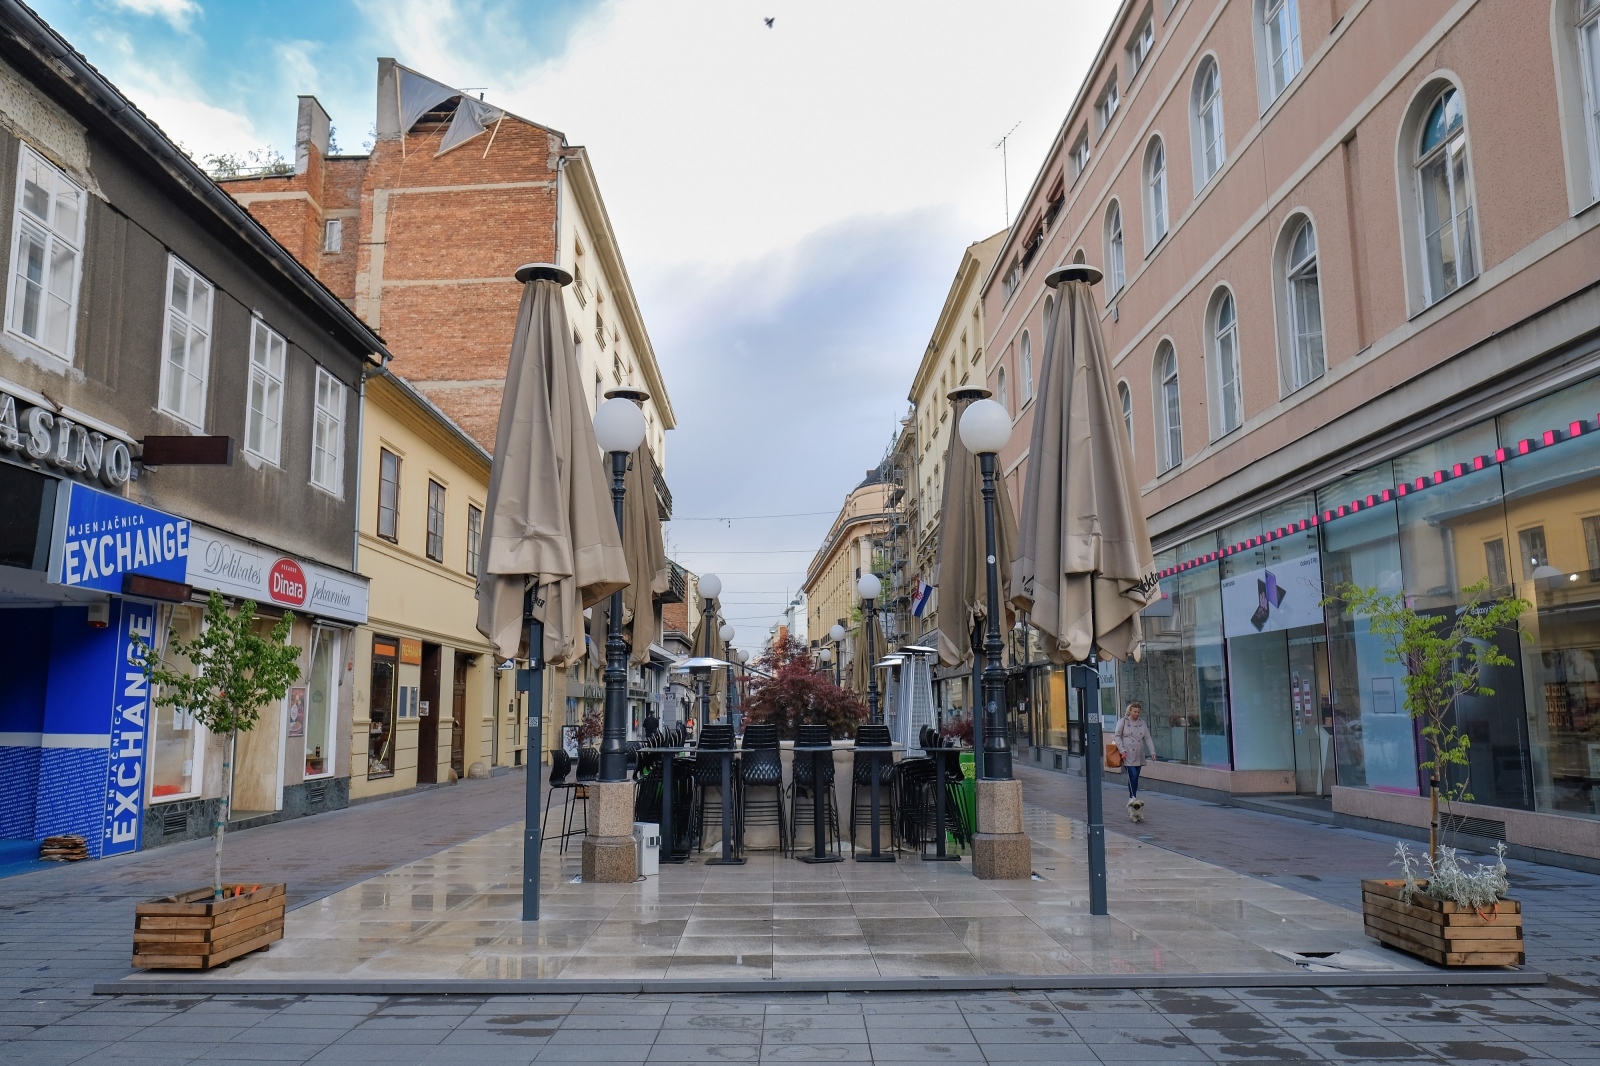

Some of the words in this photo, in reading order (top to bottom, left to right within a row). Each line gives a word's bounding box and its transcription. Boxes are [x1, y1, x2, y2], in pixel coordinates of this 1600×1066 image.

[69, 515, 145, 537] MJENJAČNICA
[65, 520, 188, 585] EXCHANGE
[203, 540, 262, 585] Delikates
[273, 572, 303, 599] Dinara
[309, 580, 352, 609] pekarnica
[1470, 606, 1488, 616] Galaxy
[112, 613, 152, 844] EXCHANGE
[104, 704, 123, 838] MJENJAČNICA
